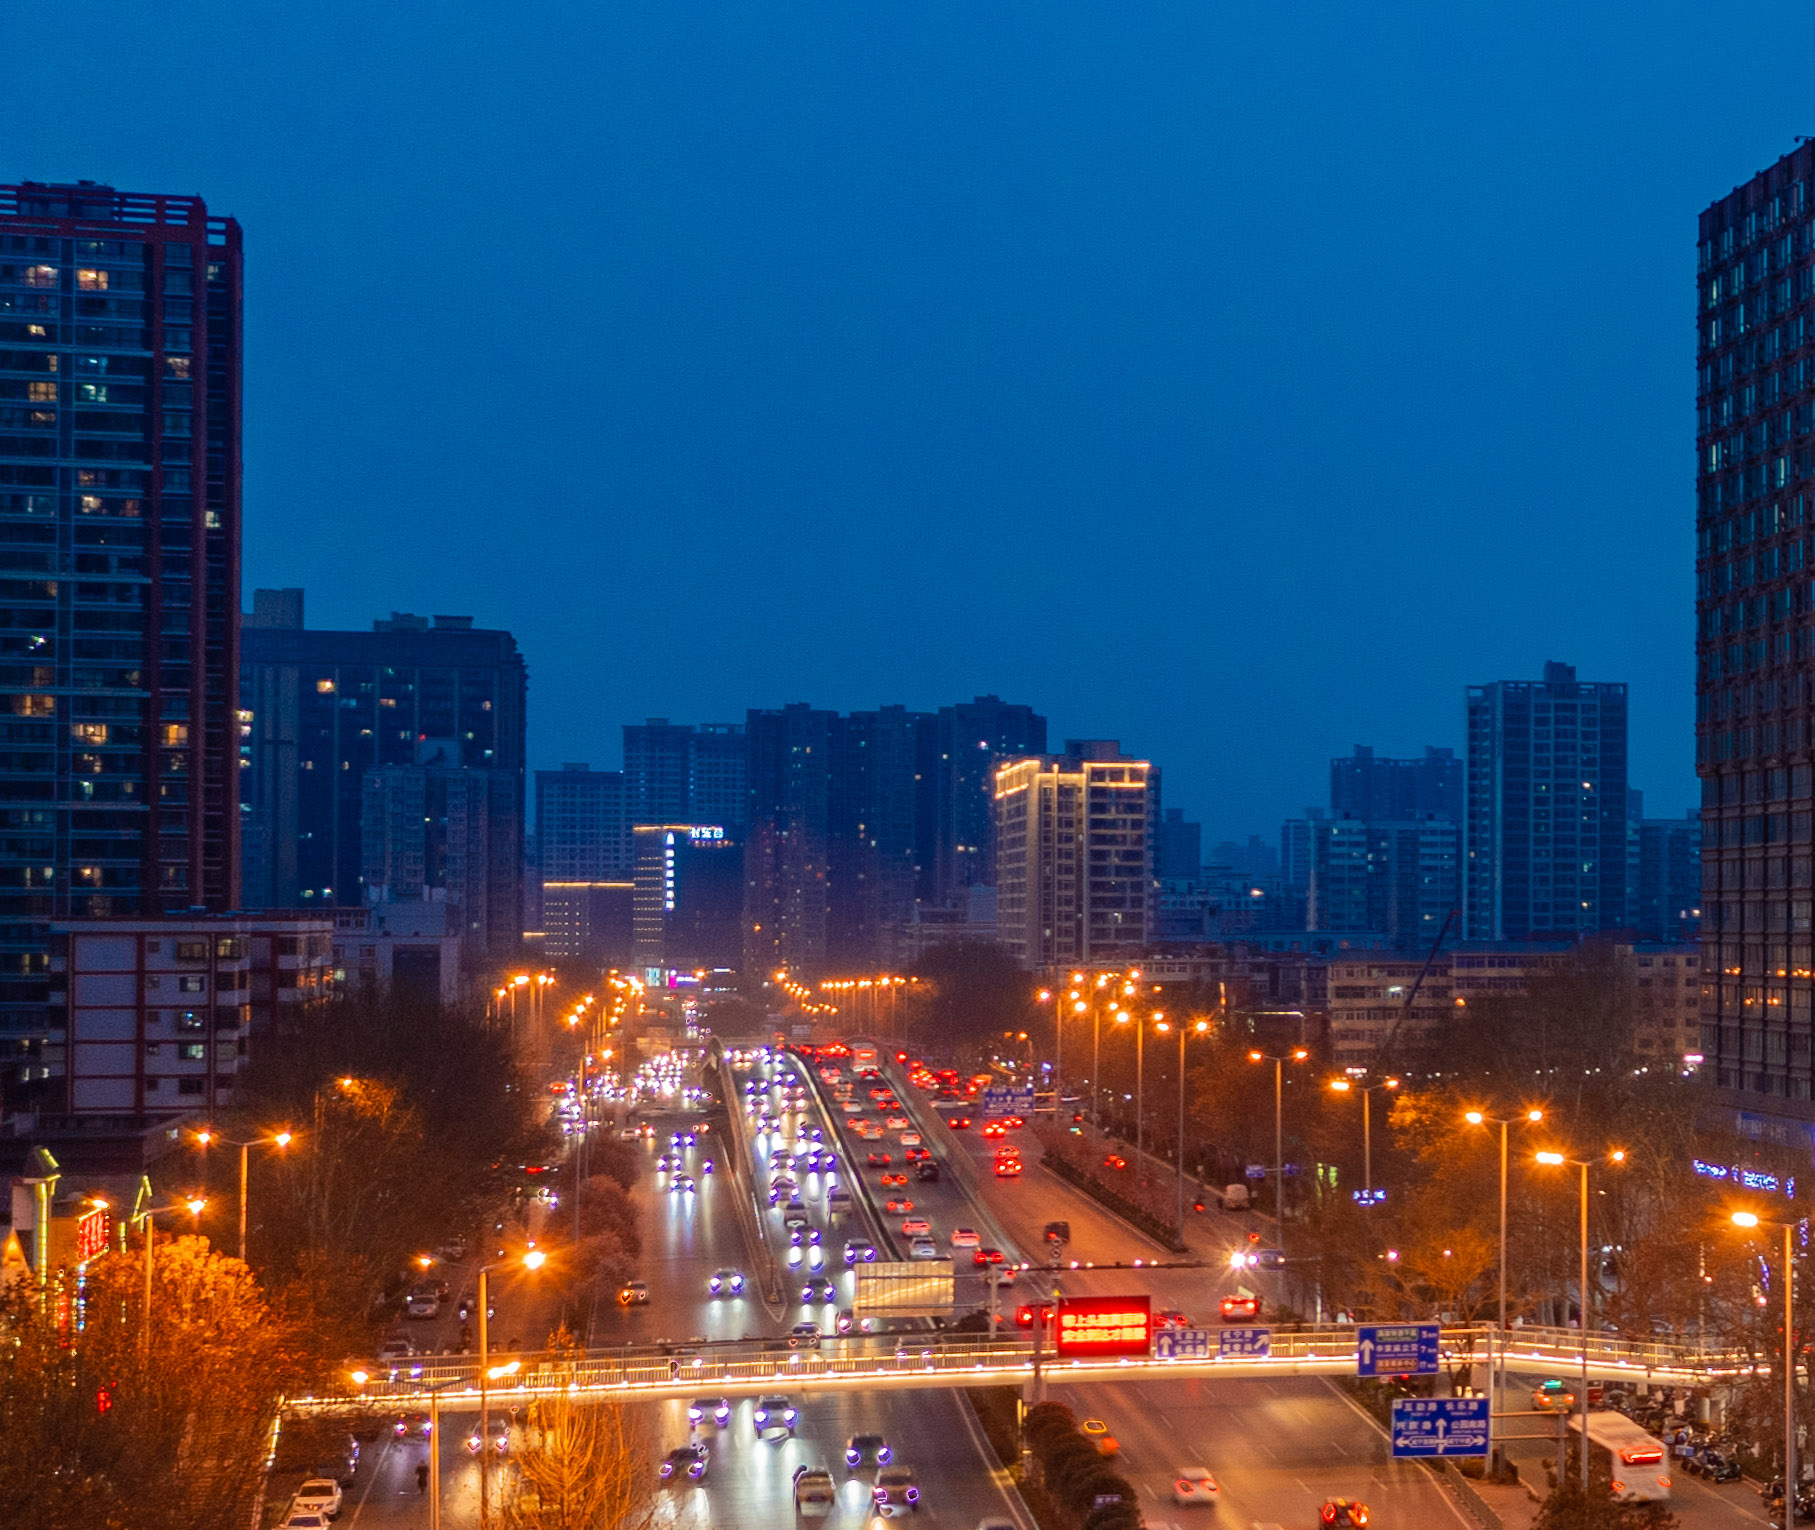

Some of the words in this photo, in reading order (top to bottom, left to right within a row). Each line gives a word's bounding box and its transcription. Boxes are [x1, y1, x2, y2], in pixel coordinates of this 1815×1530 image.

[1403, 1401, 1438, 1412] 互助路
[1445, 1401, 1479, 1411] 长乐路
